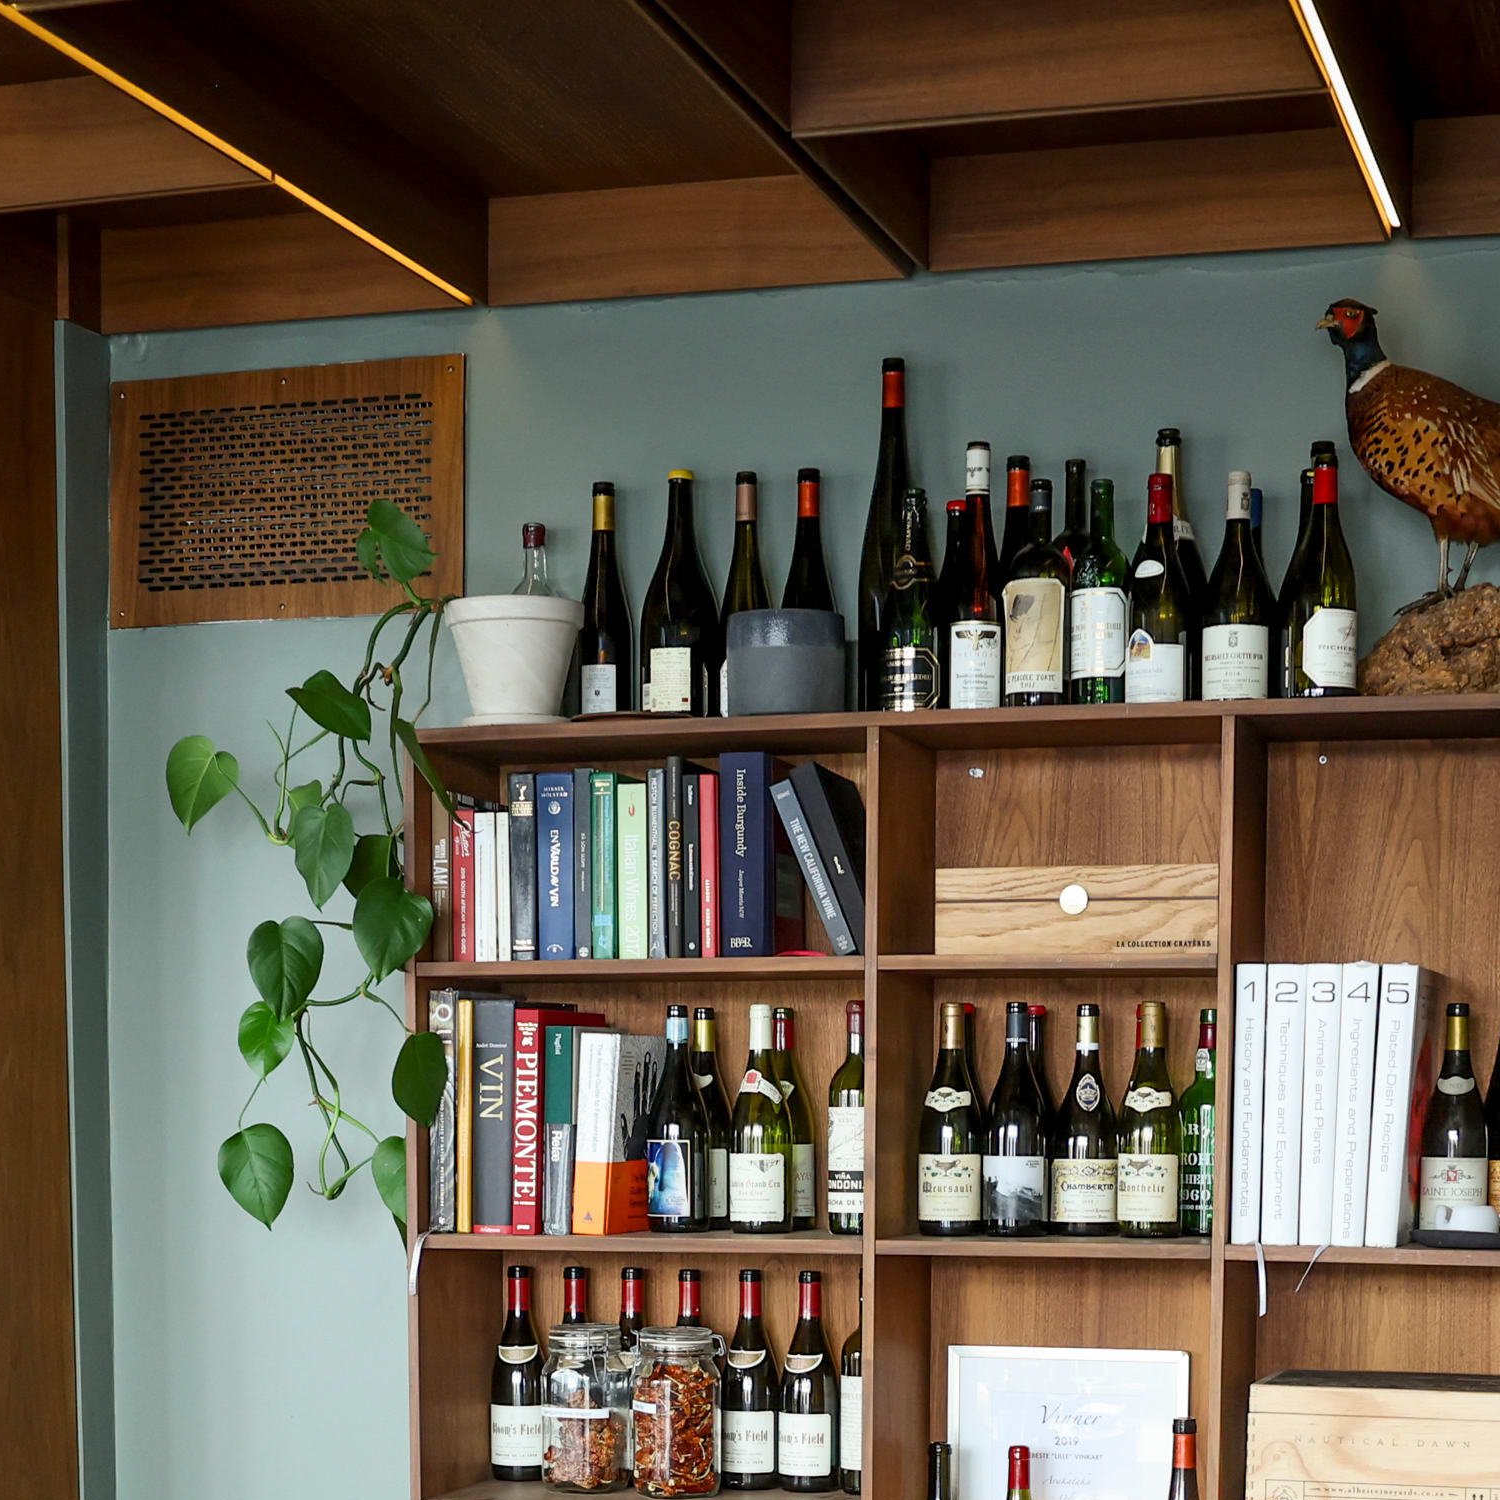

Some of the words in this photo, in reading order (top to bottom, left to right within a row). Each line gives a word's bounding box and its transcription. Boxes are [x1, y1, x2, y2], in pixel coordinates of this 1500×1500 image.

[736, 769, 746, 803] Inside
[735, 804, 747, 857] Burgundy
[623, 834, 640, 875] Italian
[668, 820, 681, 881] COGNAC
[433, 859, 448, 885] LAM
[789, 817, 801, 835] THE
[796, 832, 810, 854] NEW
[803, 852, 826, 899] CALIFORNIA
[820, 898, 836, 920] WINE
[551, 887, 560, 907] VIN
[624, 877, 640, 921] Wines
[625, 925, 640, 957] 2017
[1127, 940, 1171, 948] COLLECTION
[1243, 981, 1256, 1003] 1
[1275, 981, 1299, 1003] 2
[1311, 981, 1336, 1003] 3
[1347, 981, 1371, 1003] 4
[1386, 982, 1410, 1004] 5
[1244, 1017, 1255, 1075] History
[1315, 1019, 1328, 1077] Animals
[1276, 1020, 1290, 1102] Techniques
[1349, 1018, 1363, 1104] Ingredients
[479, 1053, 504, 1121] VIN
[1243, 1078, 1252, 1107] and
[1315, 1081, 1324, 1111] and
[513, 1050, 539, 1206] PIEMONTE!
[1277, 1106, 1286, 1135] and
[1348, 1107, 1357, 1136] and
[1312, 1116, 1325, 1165] Plants
[1380, 1112, 1394, 1174] Recipes
[834, 1171, 851, 1180] VIÑA
[1240, 1111, 1253, 1218] Fundamentals
[922, 1181, 972, 1193] Meursault
[1061, 1181, 1114, 1192] CHAMBERTIN
[1273, 1139, 1287, 1221] Equipment
[1342, 1140, 1357, 1240] Preparations
[1040, 1403, 1103, 1425] Vinner
[520, 1423, 541, 1435] Field
[746, 1429, 768, 1442] Field
[801, 1432, 824, 1445] Field
[1054, 1436, 1080, 1446] 2019
[1294, 1434, 1399, 1447] NAUTICAL
[1416, 1439, 1472, 1449] DAWN
